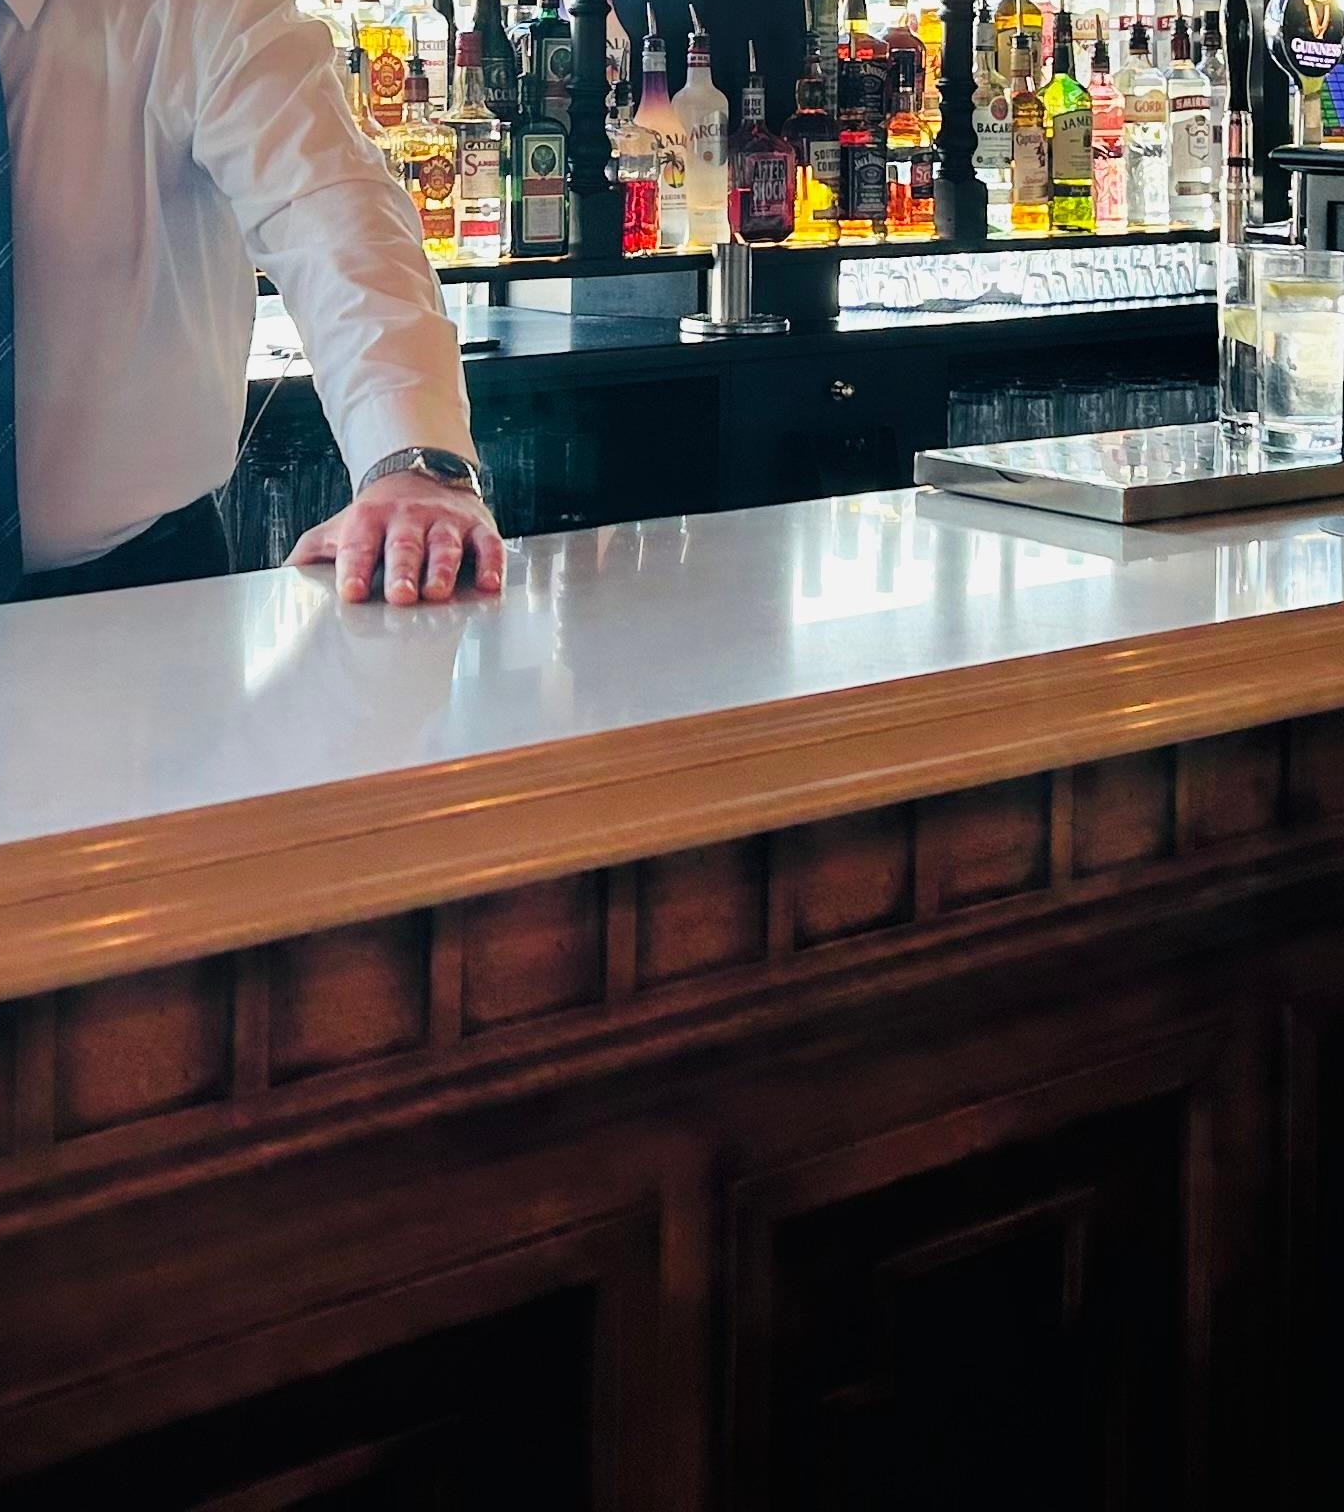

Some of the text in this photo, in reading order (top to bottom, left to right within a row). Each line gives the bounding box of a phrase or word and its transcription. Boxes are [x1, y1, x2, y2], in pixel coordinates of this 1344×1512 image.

[1291, 37, 1343, 58] GUINNESS
[754, 159, 785, 180] AFTER
[752, 180, 786, 201] SHOCK
